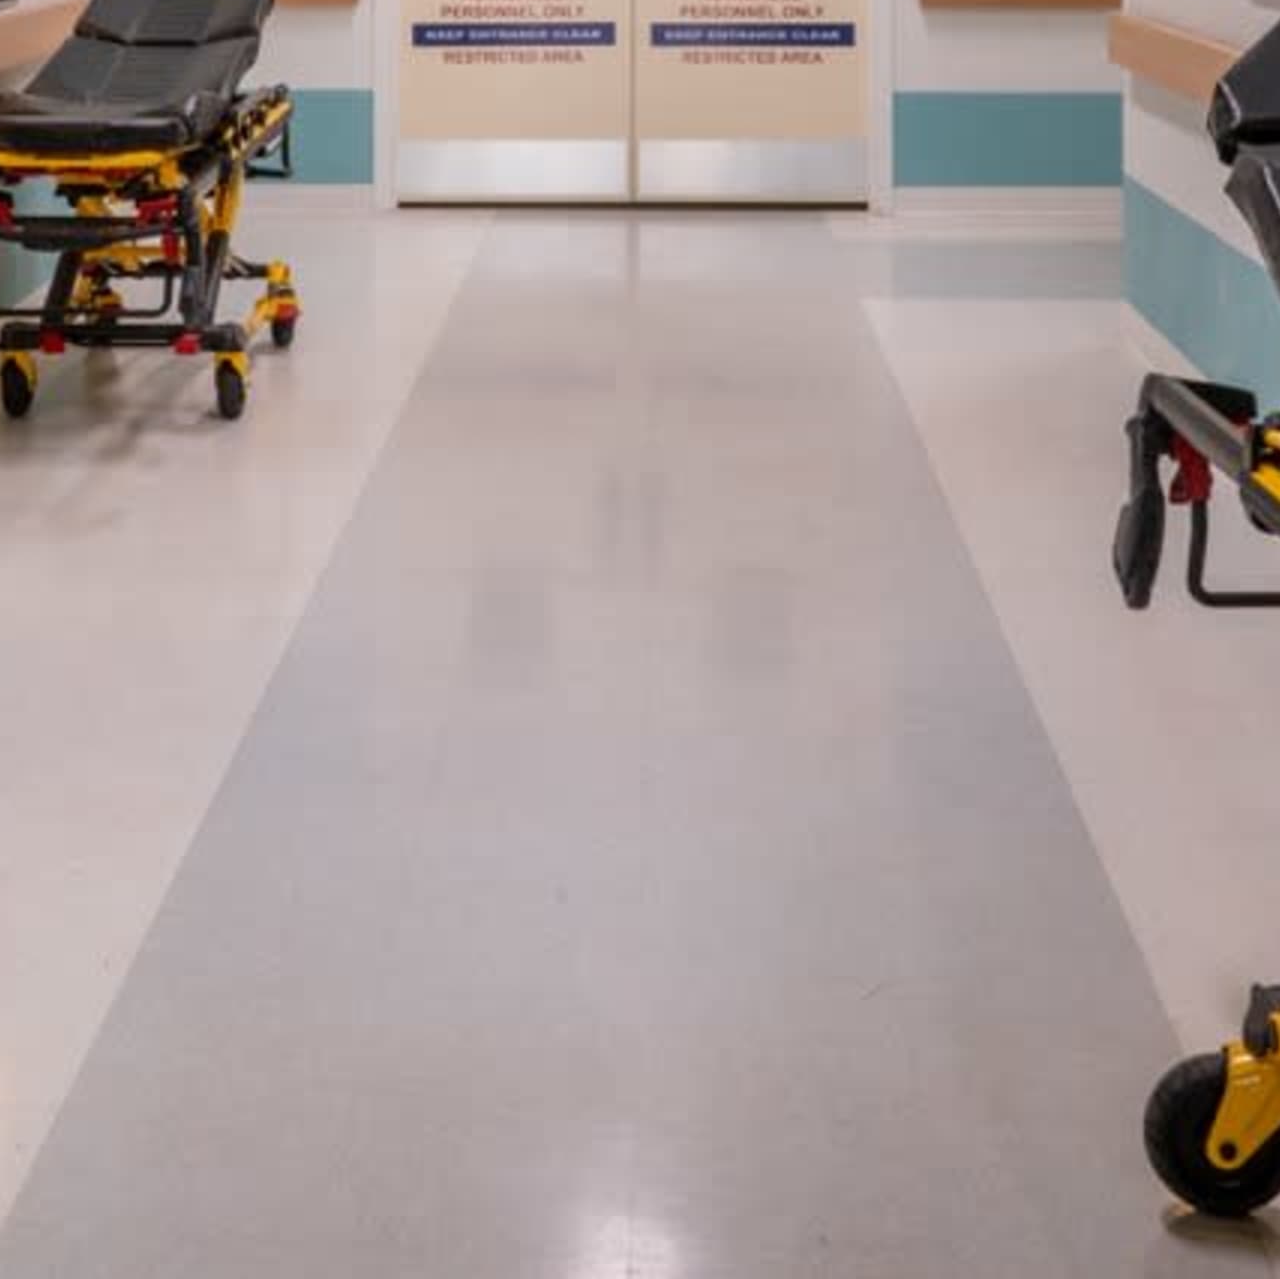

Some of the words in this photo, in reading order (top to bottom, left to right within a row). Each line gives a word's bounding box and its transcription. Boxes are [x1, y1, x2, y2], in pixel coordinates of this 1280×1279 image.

[441, 4, 536, 18] PERSONNEL
[542, 4, 585, 18] ONLY
[680, 4, 775, 18] PERSONNEL
[782, 4, 824, 18] ONLY
[442, 51, 539, 65] RESTRICTED
[541, 51, 585, 65] AREA
[682, 51, 778, 65] RESTRICTED
[780, 51, 824, 65] AREA
